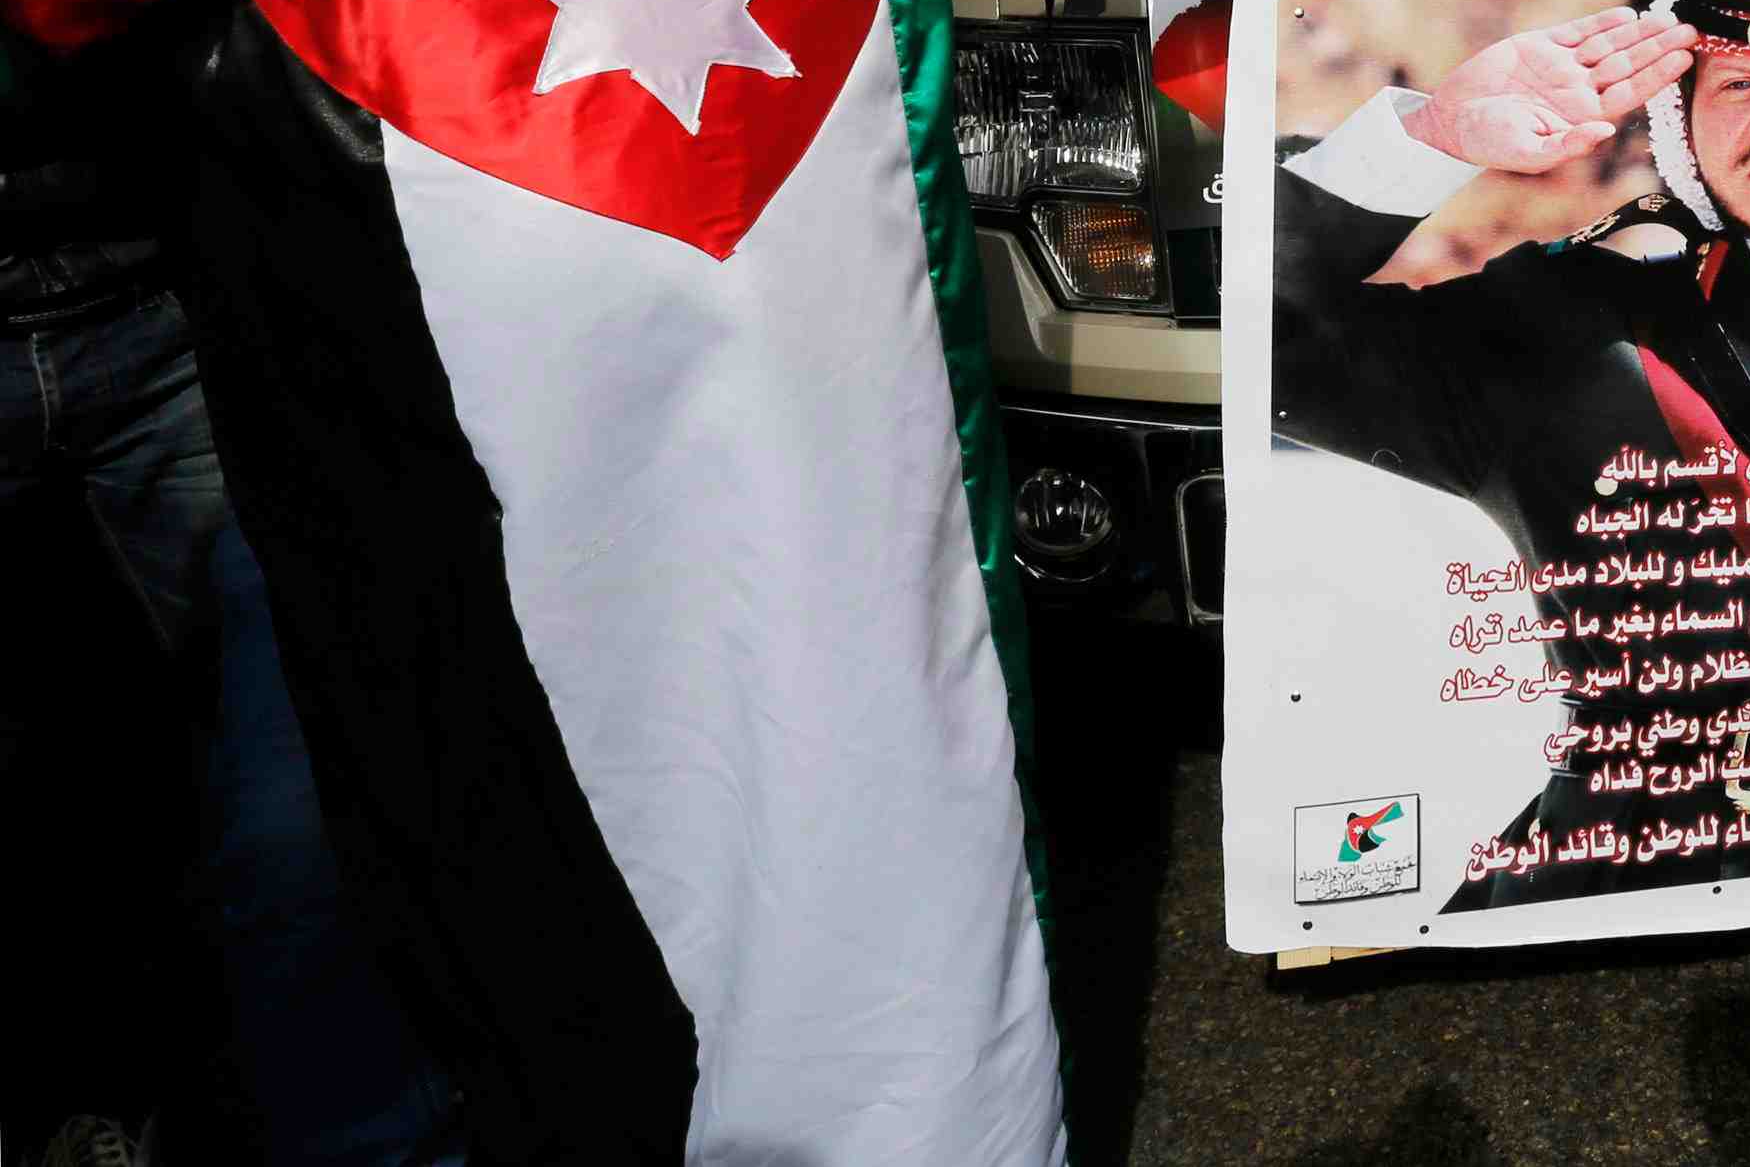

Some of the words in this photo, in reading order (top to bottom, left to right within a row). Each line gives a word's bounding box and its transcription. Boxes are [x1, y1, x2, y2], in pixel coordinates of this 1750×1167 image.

[1664, 440, 1737, 488] لأقسم
[1576, 504, 1649, 541] الجباه
[1656, 500, 1685, 528] له
[1445, 562, 1526, 603] الحياة
[1531, 562, 1587, 594] مدى
[1597, 551, 1667, 593] للبلاد
[1448, 612, 1502, 654] تراه
[1508, 614, 1567, 645] عمد
[1572, 607, 1599, 641] ما
[1609, 607, 1656, 646] بغير
[1661, 601, 1744, 636] السماء
[1439, 665, 1514, 702] خطاه
[1517, 662, 1572, 704] على
[1581, 650, 1631, 696] أسير
[1636, 656, 1684, 695] ولن
[1544, 722, 1633, 764] بروحي
[1641, 710, 1700, 761] وطني
[1589, 758, 1644, 794] فداه
[1648, 754, 1715, 795] الروح
[1464, 826, 1551, 882] الوطن
[1556, 826, 1630, 869] وقائد
[1635, 813, 1720, 864] للوطن
